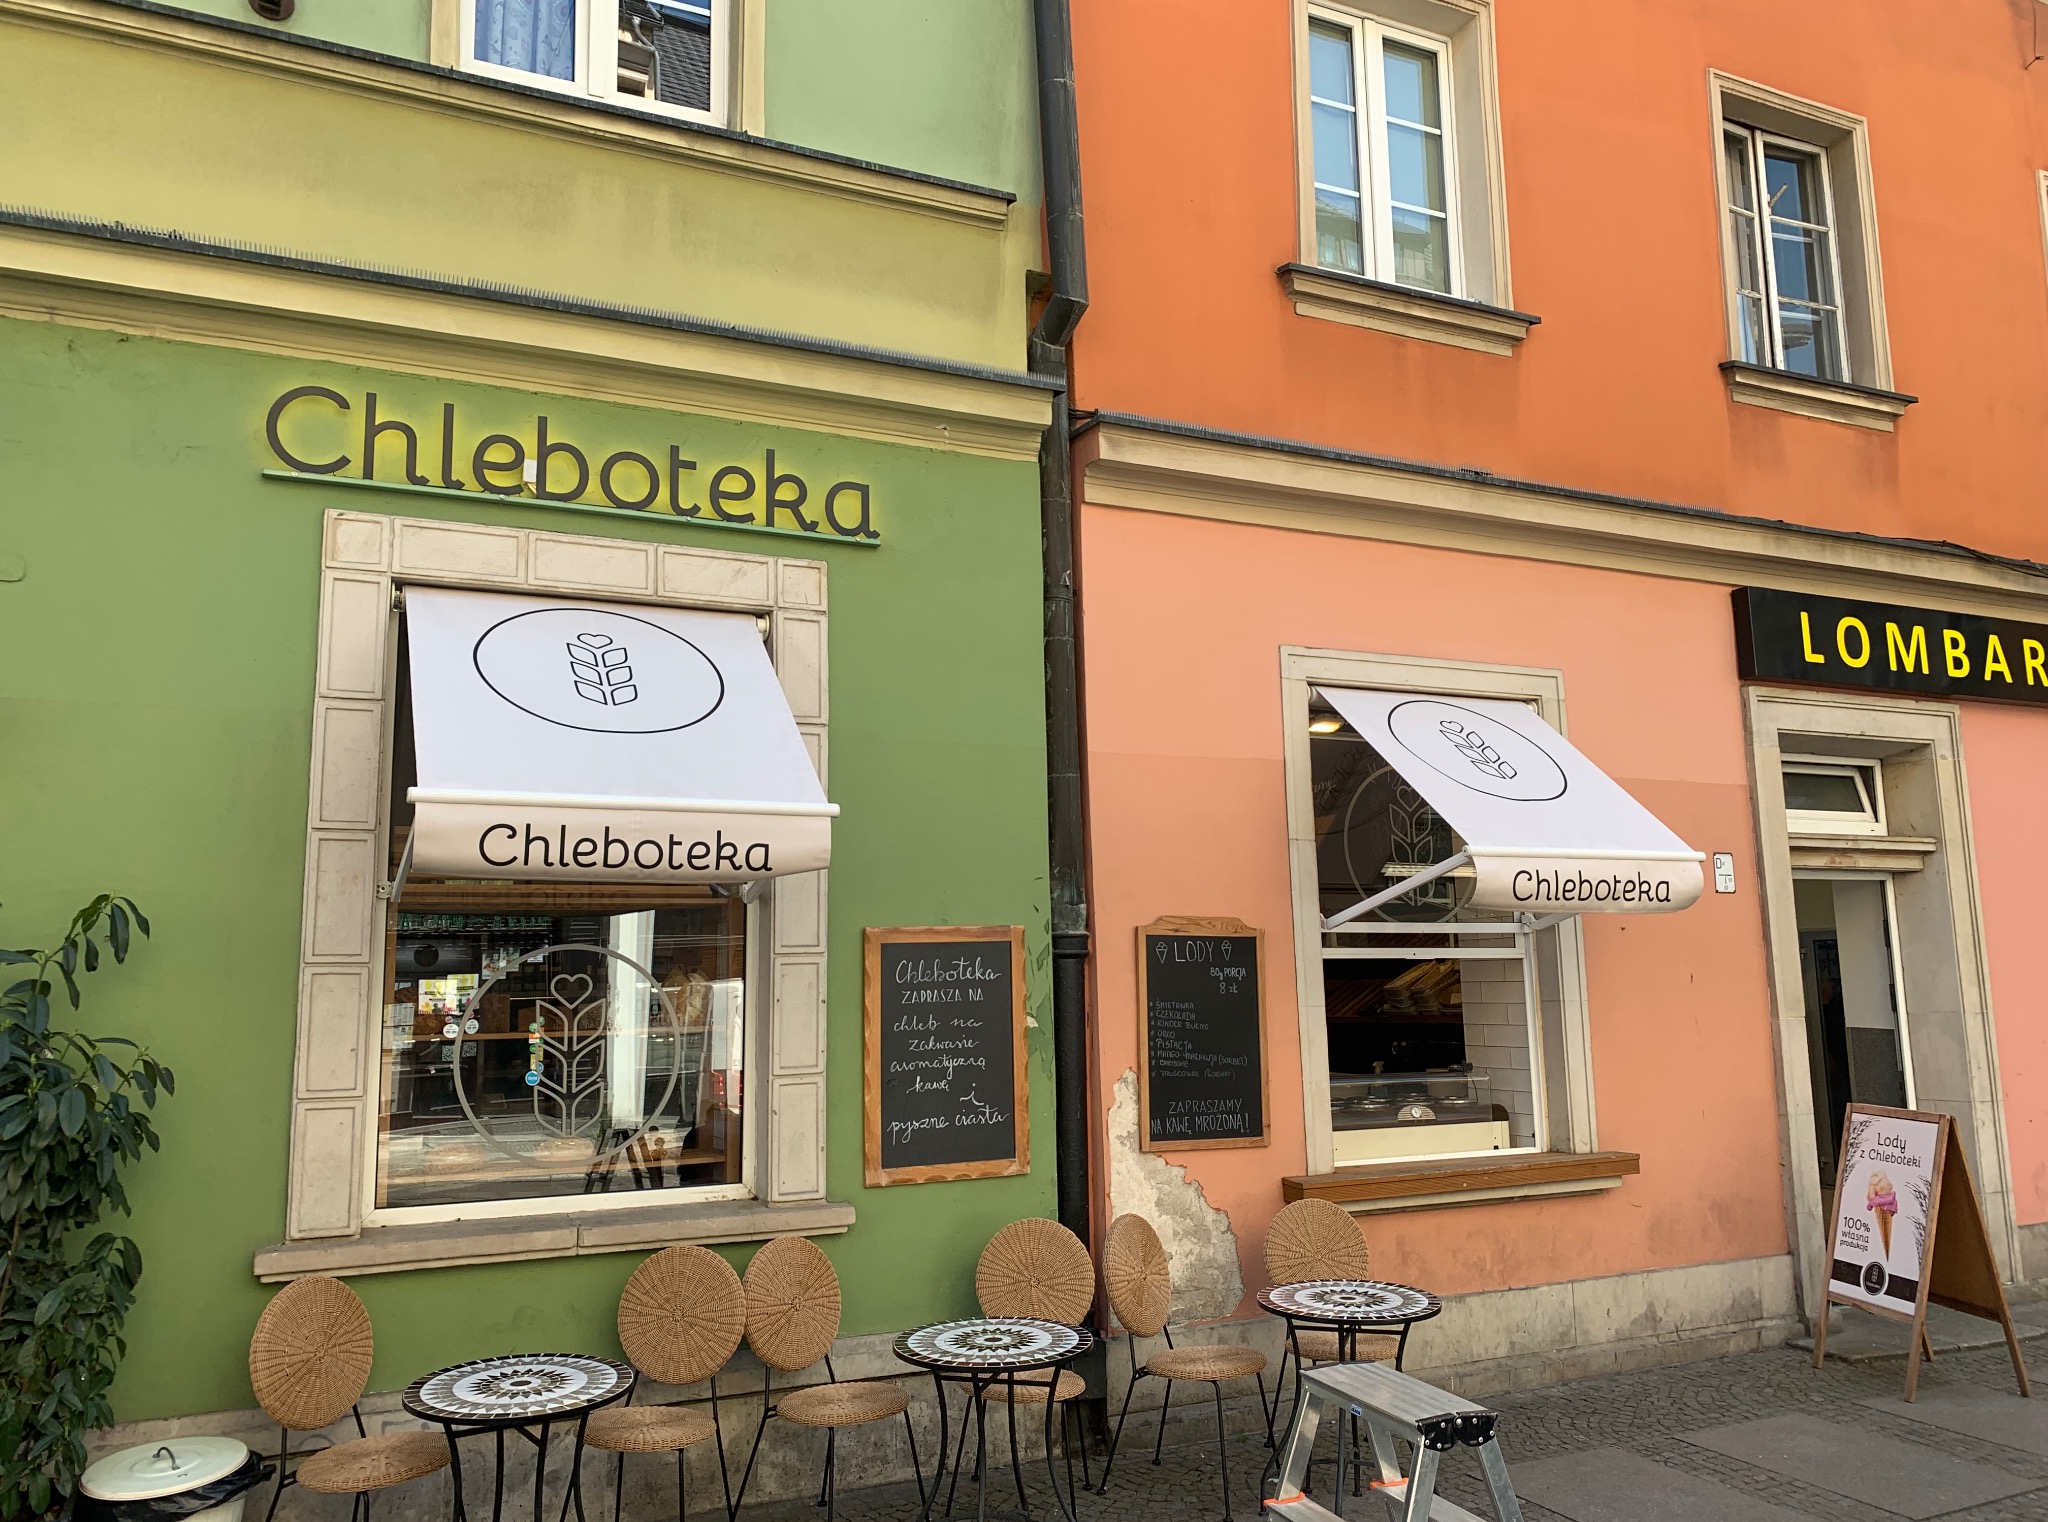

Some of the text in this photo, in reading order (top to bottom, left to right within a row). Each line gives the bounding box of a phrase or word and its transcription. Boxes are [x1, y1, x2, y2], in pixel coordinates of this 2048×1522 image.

[265, 385, 880, 539] Chleboteka
[1800, 611, 2048, 688] LOMBAR
[478, 823, 773, 872] Chleboteka
[1512, 869, 1672, 903] Chleboteka
[1174, 940, 1215, 963] LODY
[895, 957, 1002, 983] Chleboteka
[1223, 966, 1247, 981] PORCJA
[901, 987, 984, 1004] ZAPRASZA NA
[1219, 981, 1238, 995] 8 zł
[893, 1014, 984, 1032] chleb na
[1155, 1010, 1196, 1021] CZEKOLADA
[1157, 1020, 1183, 1028] KINDER
[908, 1034, 980, 1052] zakwasie
[1157, 1030, 1176, 1039] OREO
[1155, 1038, 1193, 1052] PISTACJA
[889, 1053, 987, 1081] aromatyczną
[906, 1075, 951, 1094] kawę
[1168, 1097, 1242, 1115] ZAPRASZAMY
[887, 1103, 1011, 1146] pyszne ciasta
[1150, 1112, 1250, 1135] NA KAWĘ MROŻONĄ!
[1876, 1131, 1907, 1154] Lody
[1860, 1148, 1921, 1168] z Chleboteki
[1843, 1215, 1871, 1233] 100%
[1841, 1229, 1870, 1244] własna
